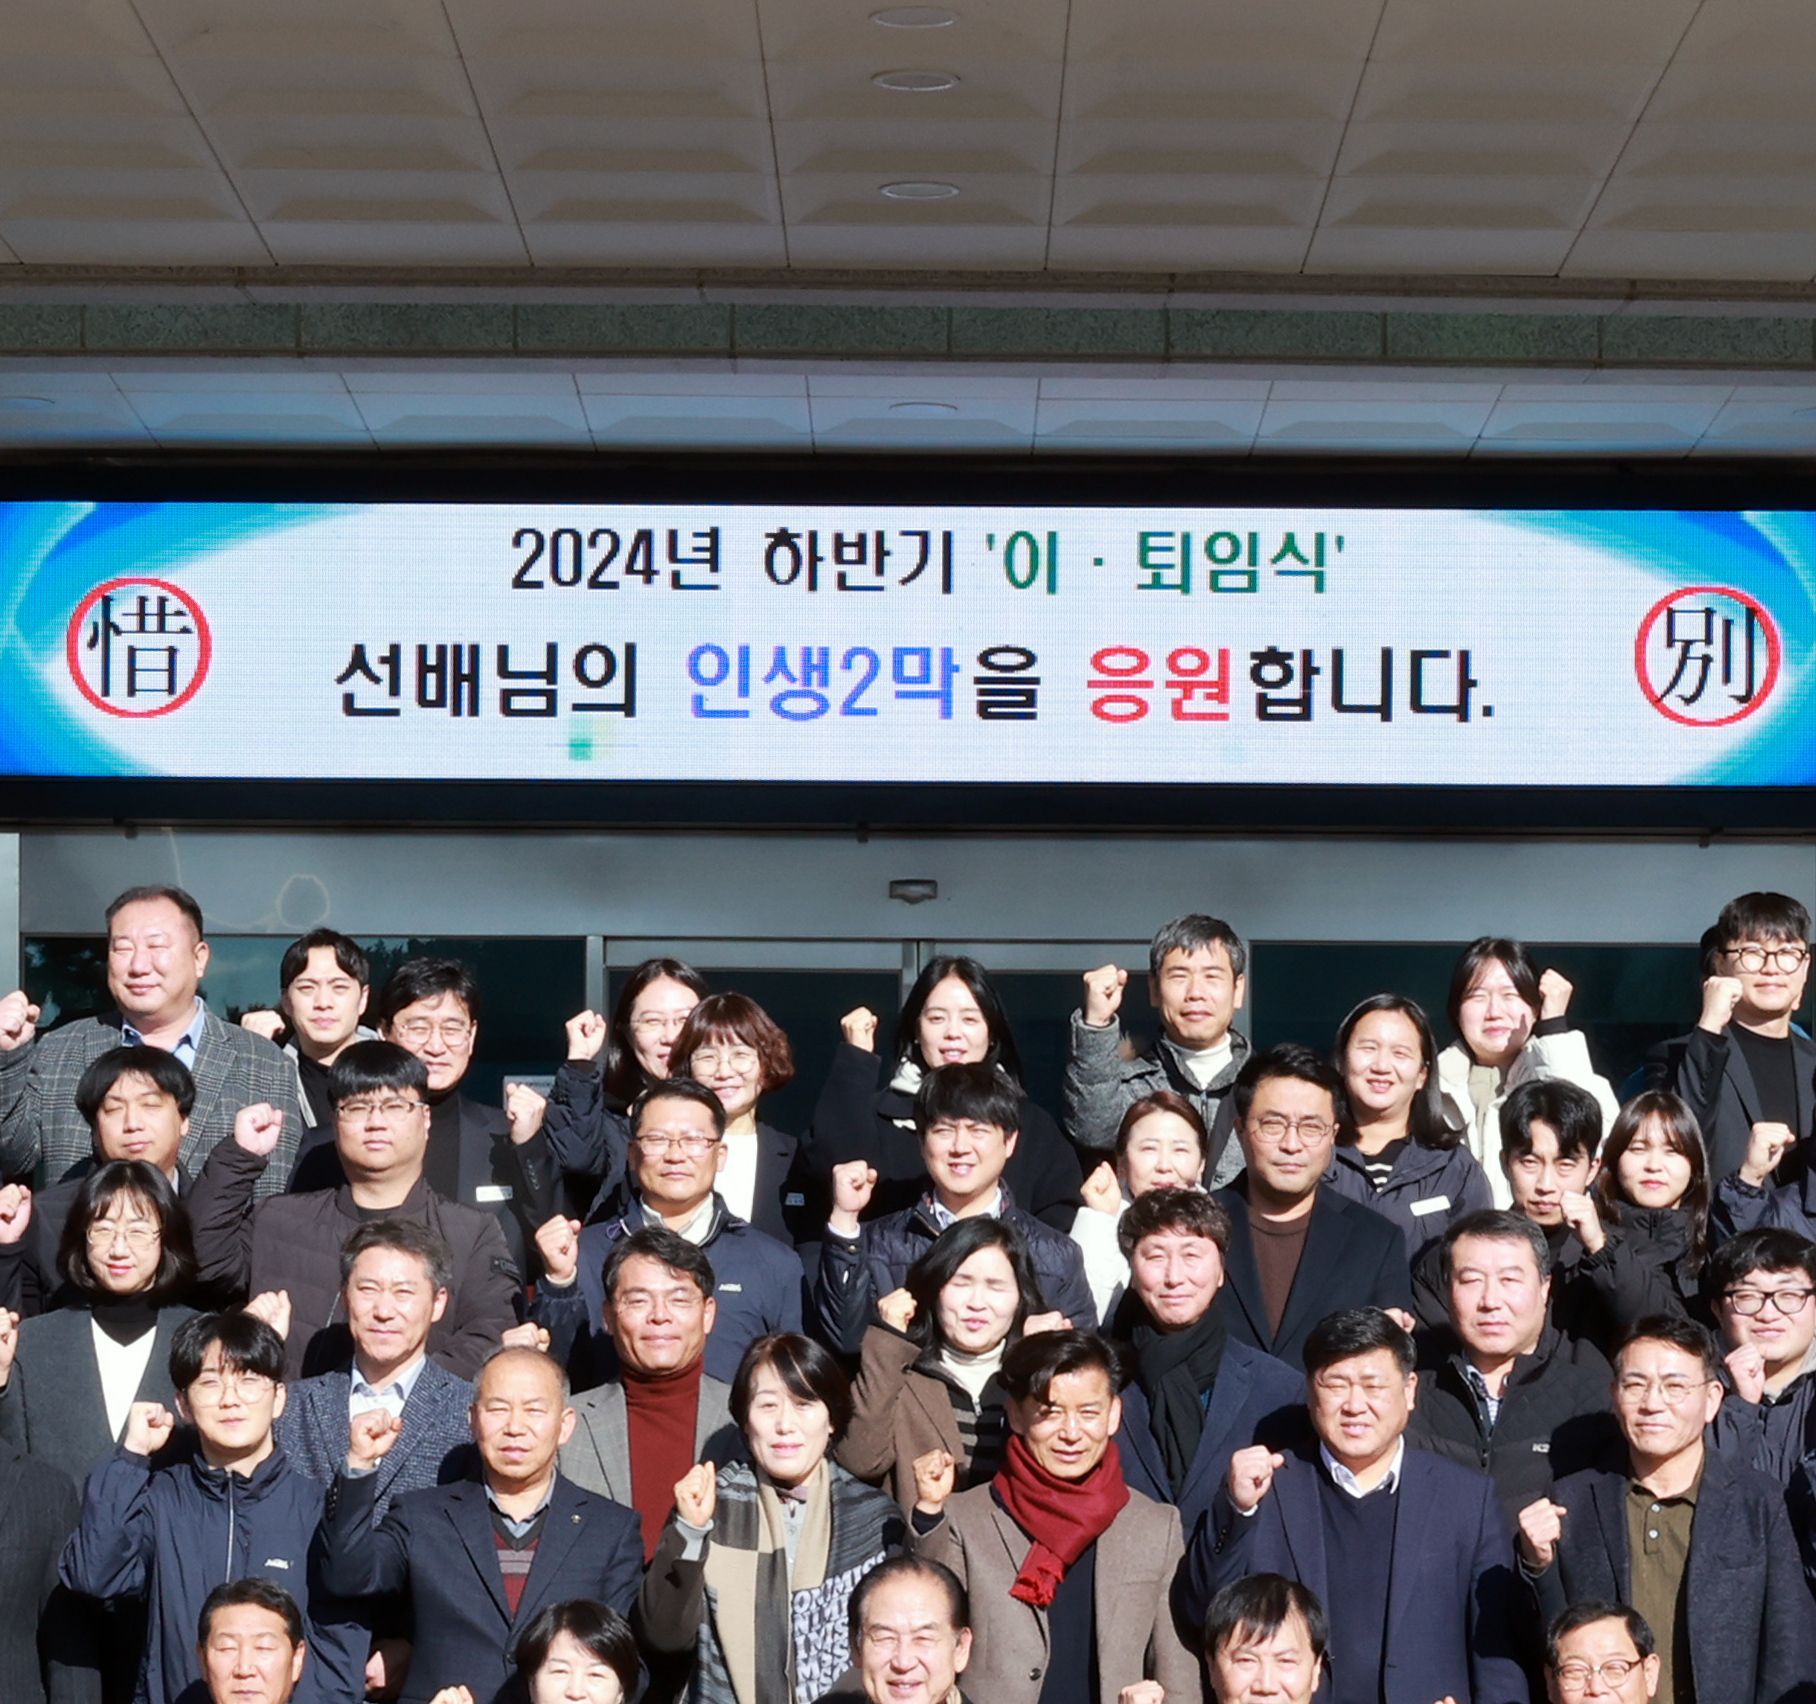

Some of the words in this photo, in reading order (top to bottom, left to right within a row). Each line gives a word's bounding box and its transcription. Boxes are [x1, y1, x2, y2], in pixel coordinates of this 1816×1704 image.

[511, 525, 721, 590] 2024년
[763, 526, 954, 594] 하반기
[1136, 530, 1344, 595] 퇴임식'
[87, 594, 193, 697] 惜
[335, 641, 637, 718] 선배님의
[687, 643, 1041, 721] 인생2막을
[1086, 645, 1495, 723] 응원합니다.
[1656, 606, 1756, 706] 別
